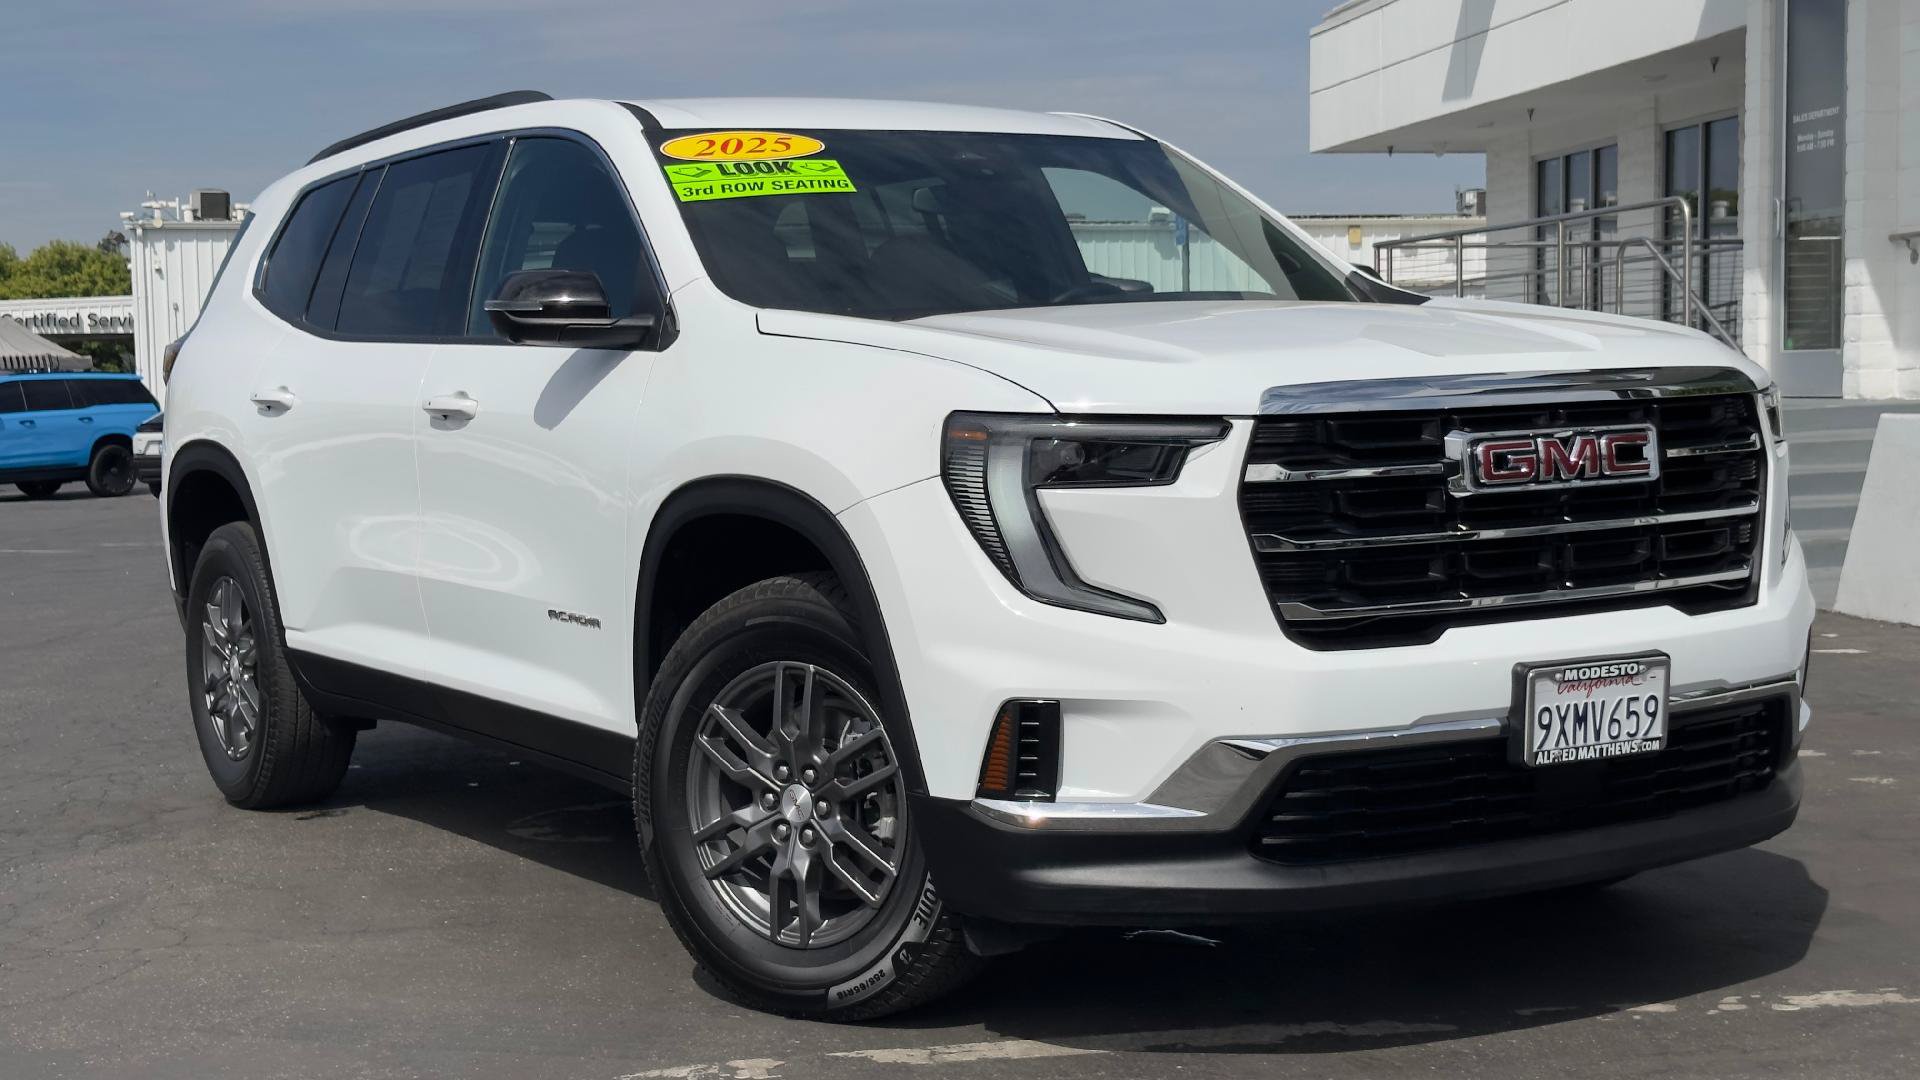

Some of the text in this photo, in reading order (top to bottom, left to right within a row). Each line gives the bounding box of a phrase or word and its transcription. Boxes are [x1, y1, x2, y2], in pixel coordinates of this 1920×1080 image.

[1808, 106, 1839, 120] DEPARTMENT
[693, 137, 793, 157] 2025
[716, 161, 799, 176] LOOK
[682, 179, 849, 197] 3rd ROW SEATING
[1477, 432, 1652, 484] GMC
[1564, 663, 1639, 681] MODESTO
[1557, 675, 1641, 698] California
[1536, 695, 1659, 750] 9XMV659
